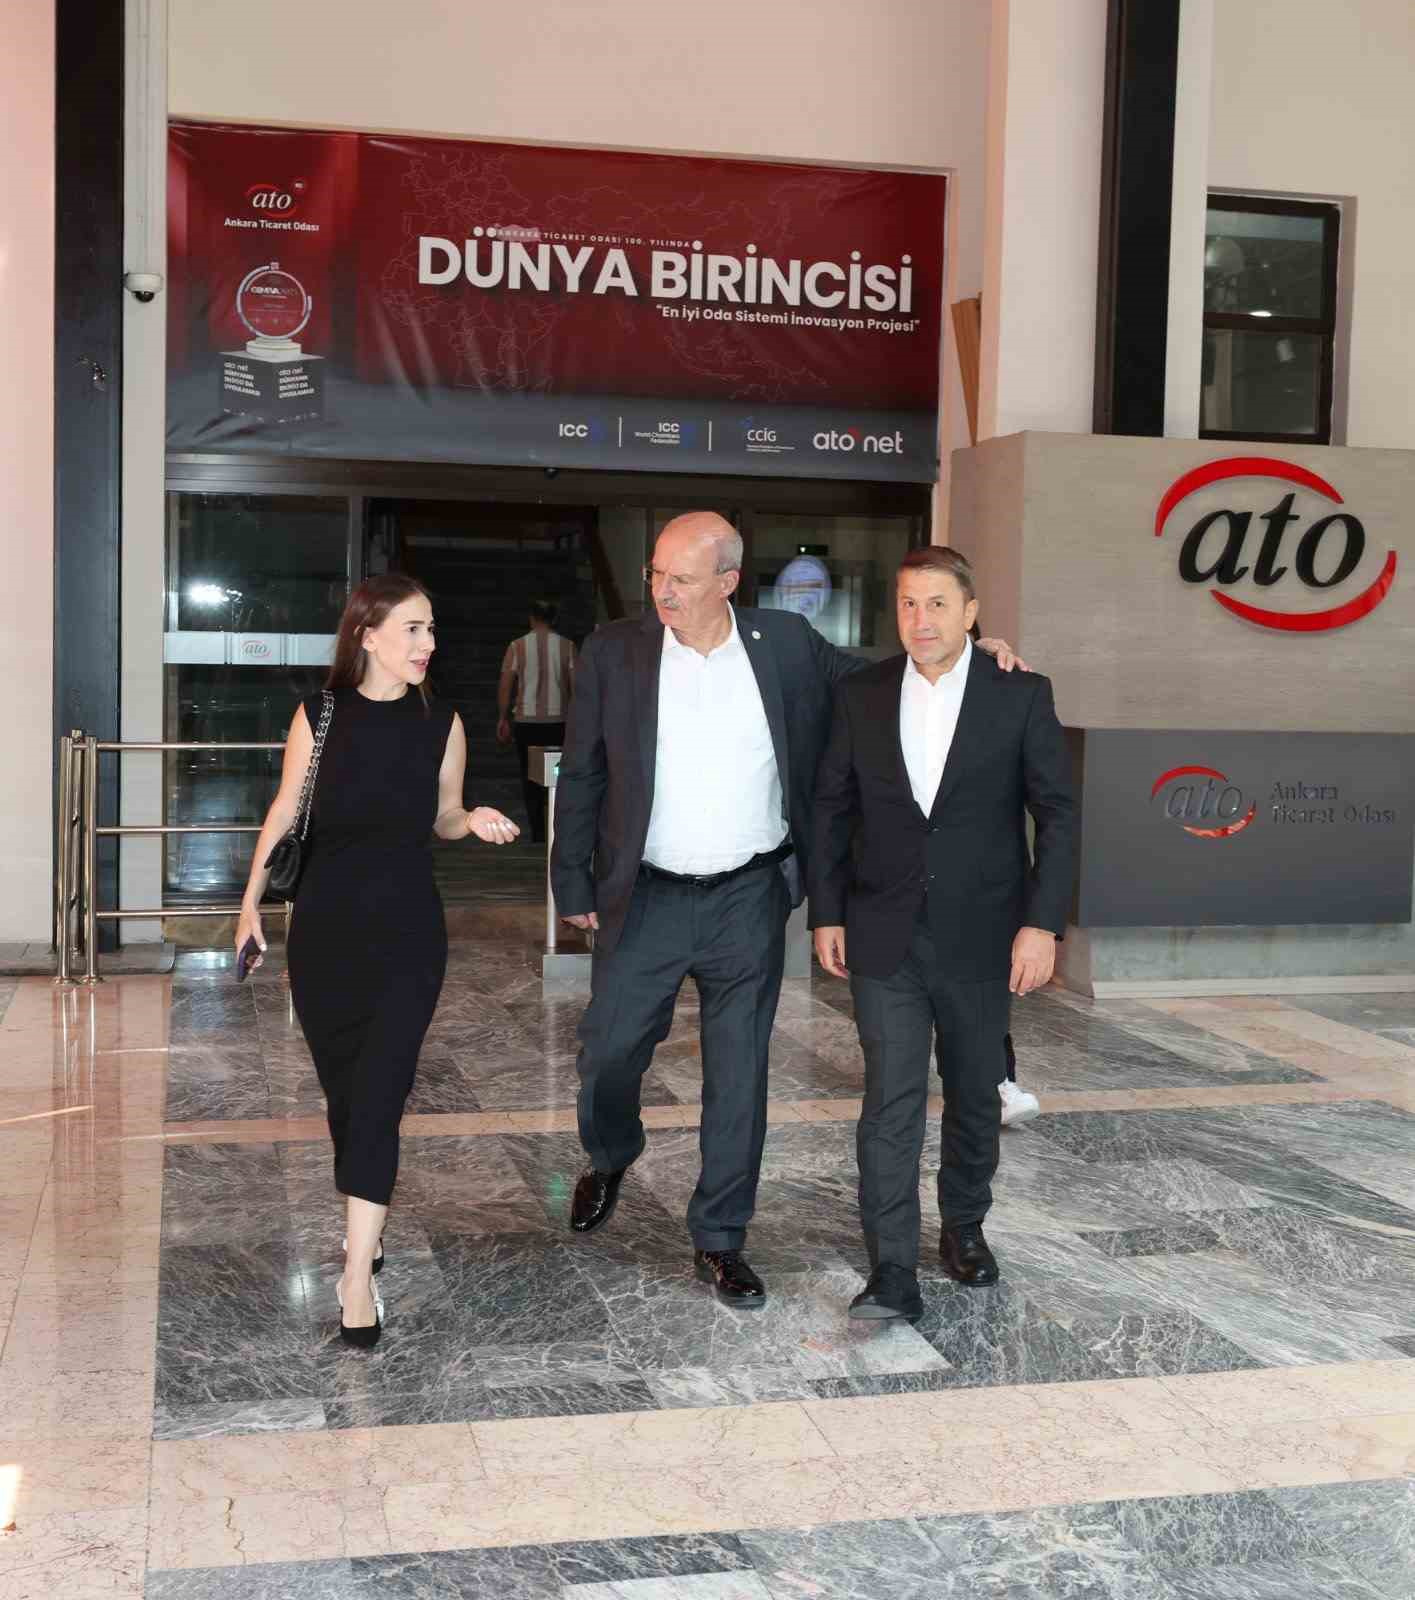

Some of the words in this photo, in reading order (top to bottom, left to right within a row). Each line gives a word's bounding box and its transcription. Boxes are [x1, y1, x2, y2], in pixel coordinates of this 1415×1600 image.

[252, 191, 292, 209] ato
[224, 218, 258, 228] Ankara
[259, 220, 292, 230] Ticaret
[293, 222, 320, 231] Odası
[418, 226, 639, 297] DÜNYA
[651, 239, 913, 313] BİRİNCİSİ
[682, 305, 700, 322] İyi
[703, 308, 733, 321] Oda
[735, 310, 788, 325] Sistemi
[791, 312, 864, 331] İnovasyon
[559, 423, 588, 438] ICC
[658, 422, 680, 433] ICC
[813, 430, 855, 451] ato
[863, 431, 903, 454] net
[1178, 493, 1366, 588] ato
[245, 644, 266, 654] ato
[1164, 777, 1243, 819] ato
[1271, 781, 1339, 801] Ankara
[1271, 804, 1335, 825] Ticaret
